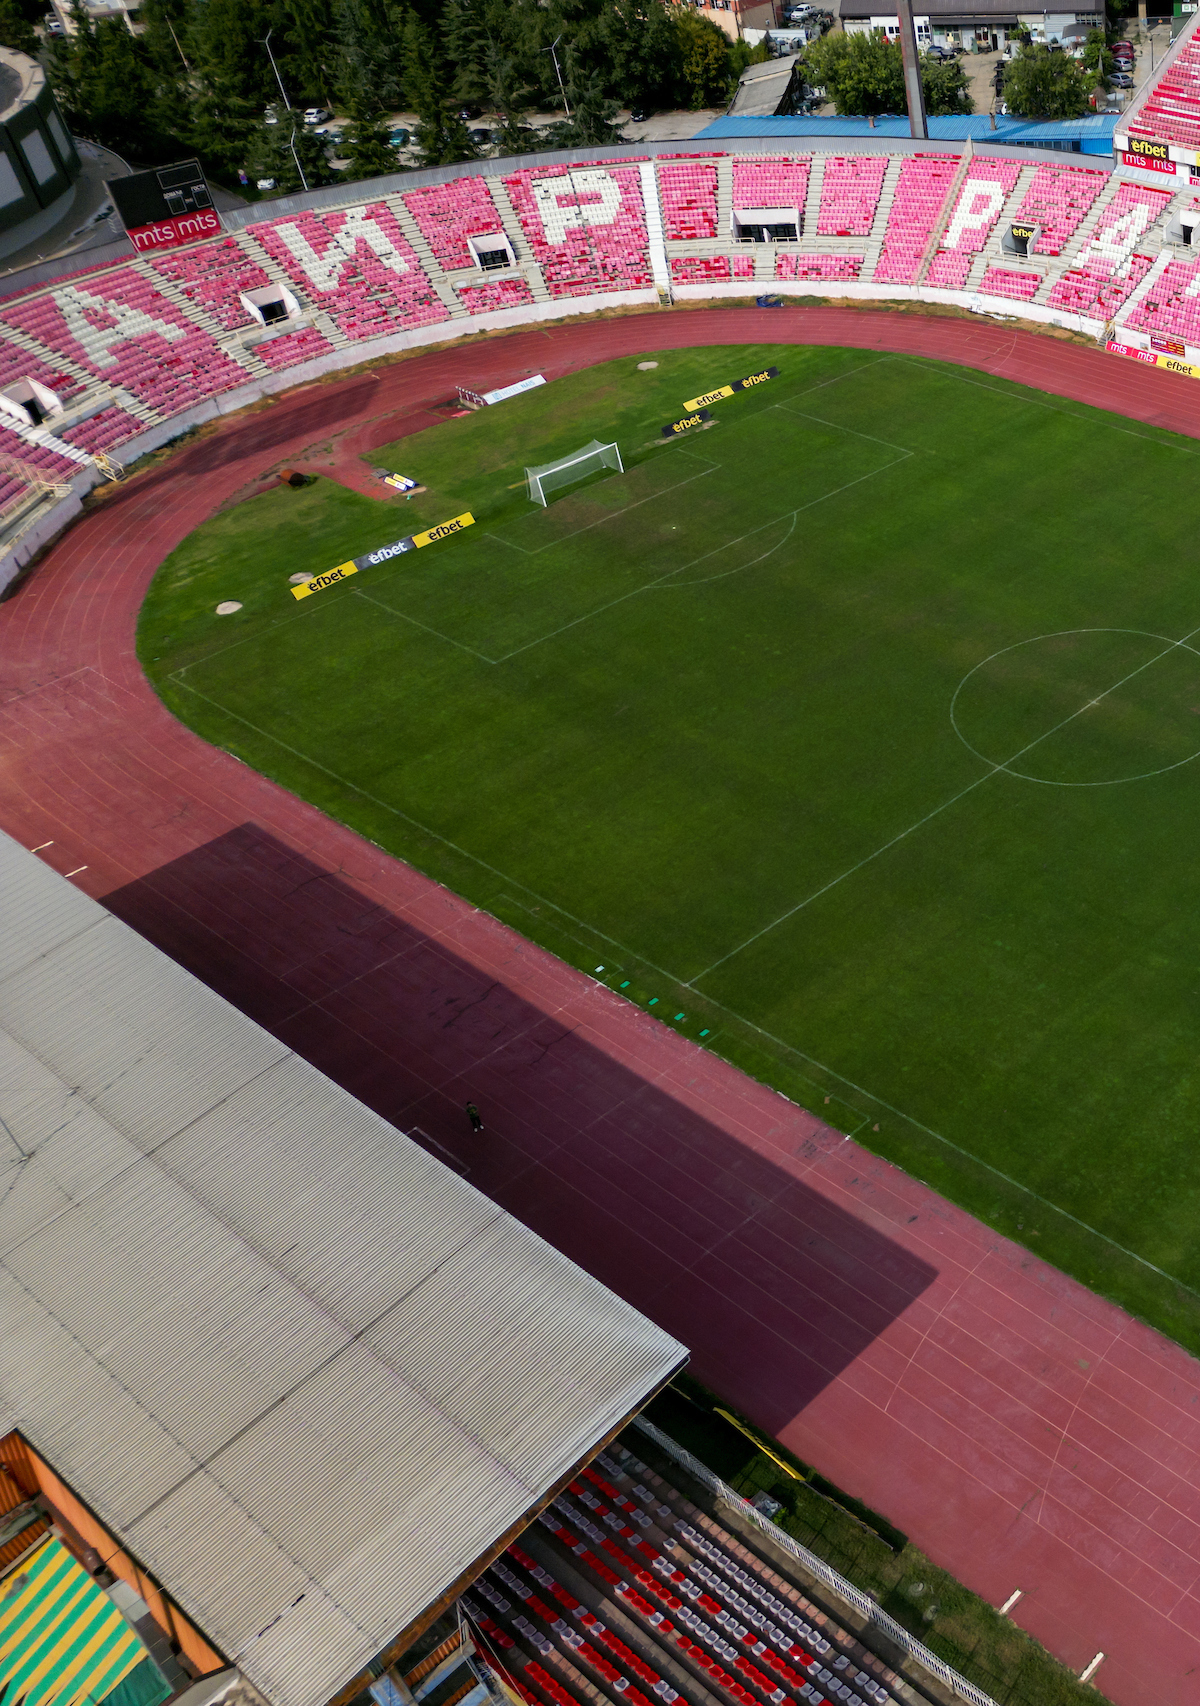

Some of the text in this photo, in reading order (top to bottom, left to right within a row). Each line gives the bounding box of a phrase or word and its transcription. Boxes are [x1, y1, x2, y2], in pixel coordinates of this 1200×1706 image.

[1131, 140, 1166, 158] efbet
[1126, 153, 1174, 172] mts mts
[134, 214, 217, 248] mts mts
[1012, 228, 1033, 238] efbe
[1110, 343, 1154, 363] mts mts
[1166, 360, 1193, 375] efbet
[742, 370, 770, 388] efbet
[696, 391, 725, 406] efbet
[672, 414, 702, 432] efbet
[428, 519, 464, 540] efbet
[368, 541, 407, 564] efbet
[307, 568, 346, 592] efbet
